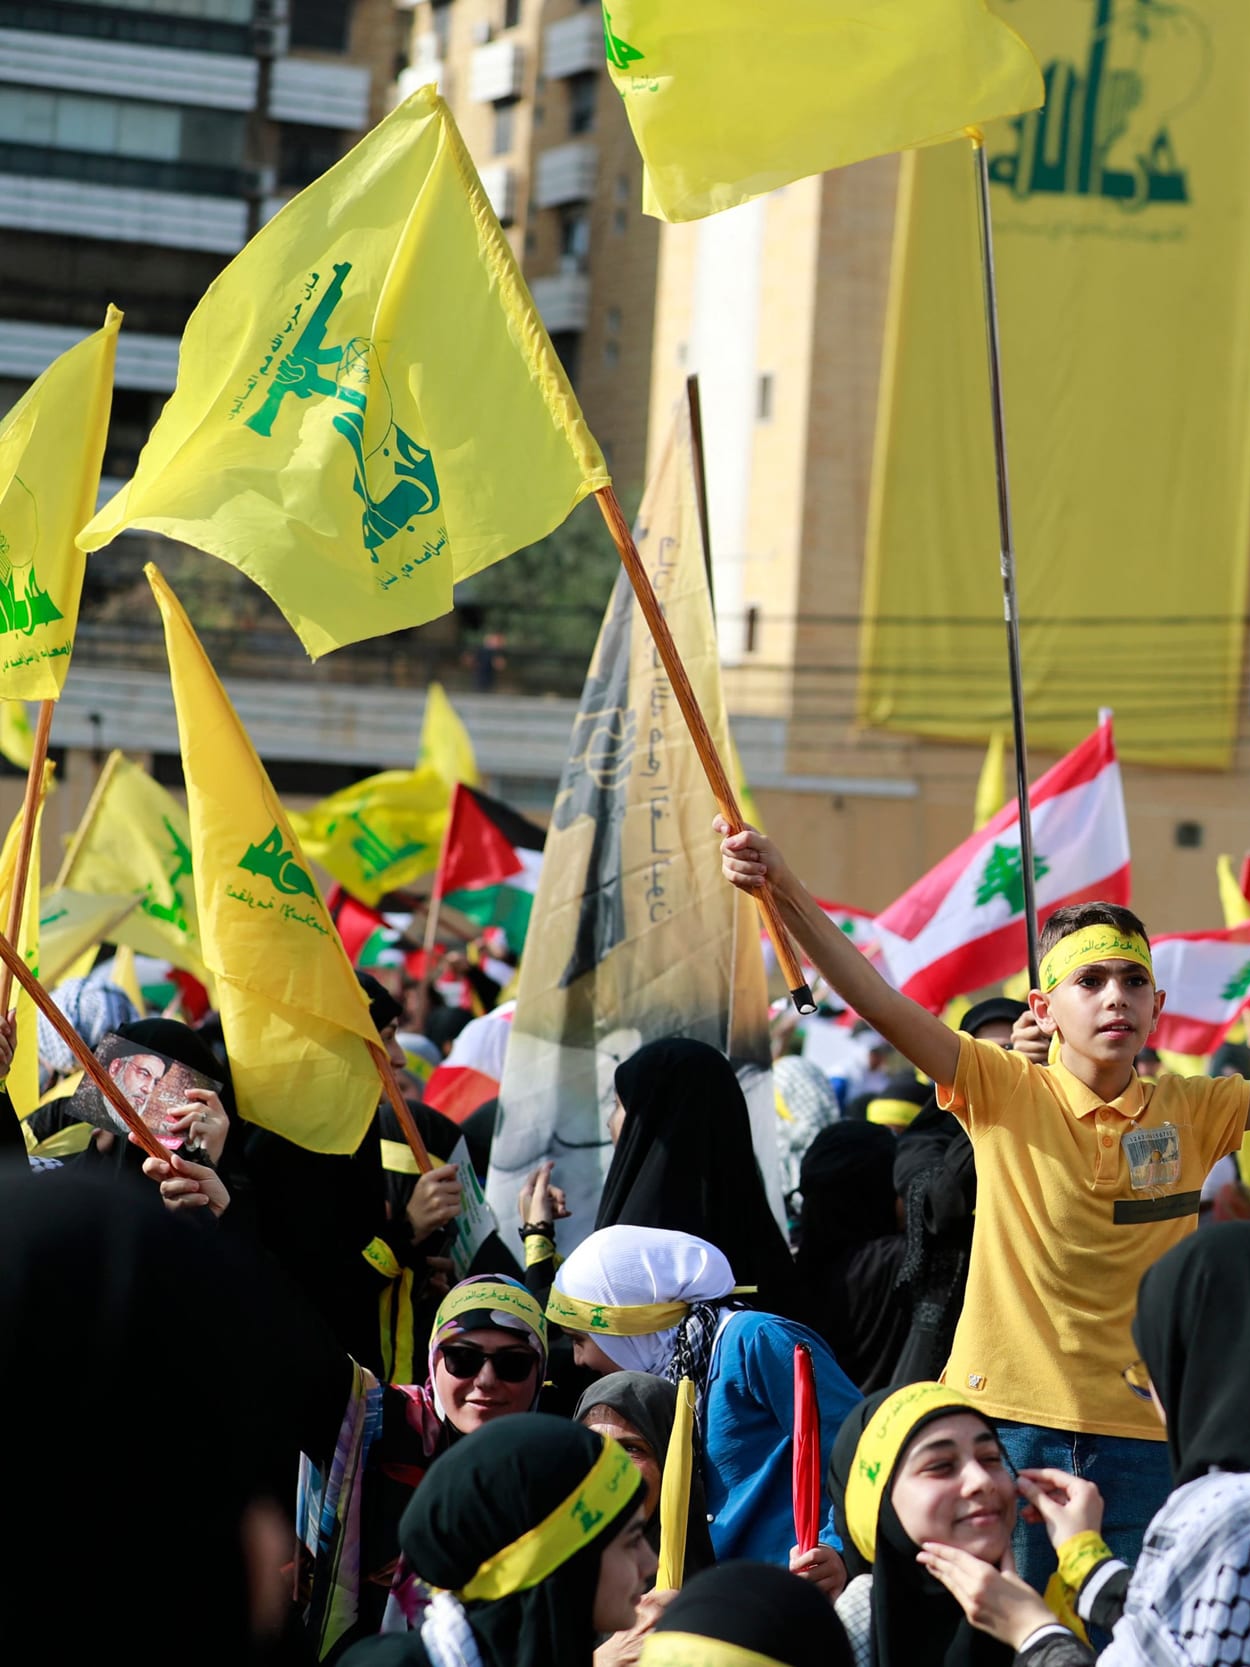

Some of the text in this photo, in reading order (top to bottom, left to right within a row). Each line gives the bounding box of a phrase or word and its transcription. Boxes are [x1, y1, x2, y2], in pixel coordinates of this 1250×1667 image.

[300, 272, 320, 301] فإن
[271, 334, 284, 353] الله
[259, 355, 274, 376] هم
